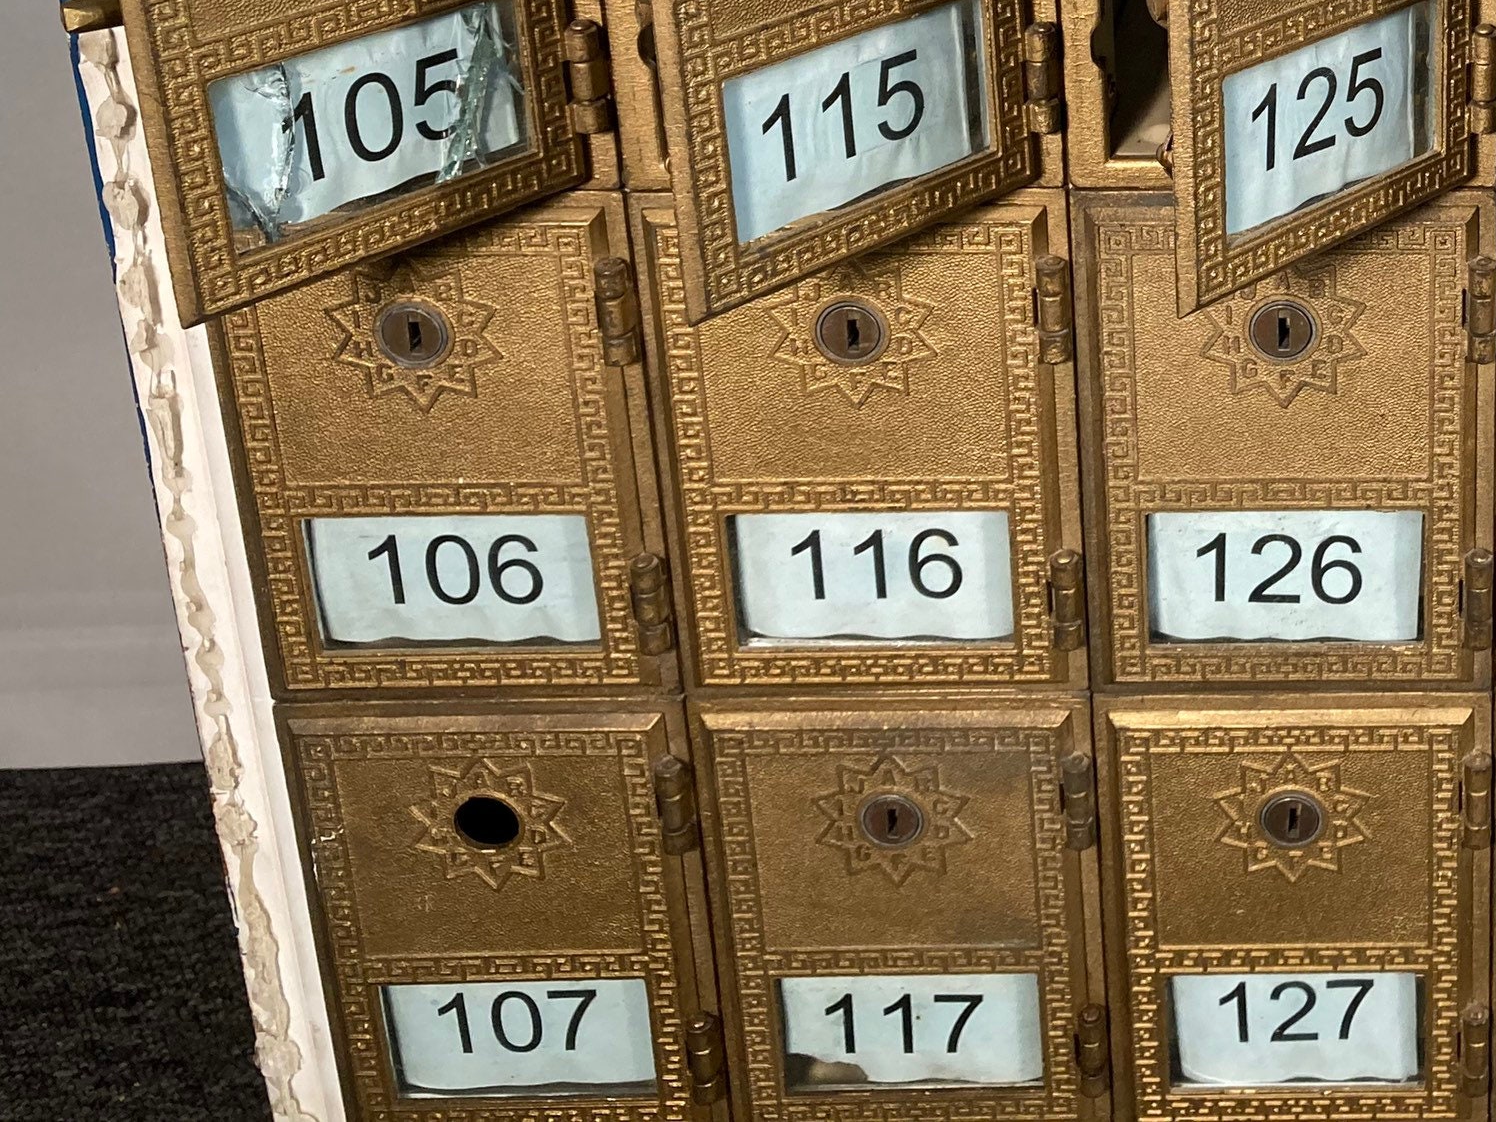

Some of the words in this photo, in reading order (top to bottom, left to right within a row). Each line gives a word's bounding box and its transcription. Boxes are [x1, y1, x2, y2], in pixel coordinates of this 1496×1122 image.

[282, 47, 466, 182] 105
[763, 49, 924, 181] 115
[1252, 47, 1385, 171] 125
[369, 535, 543, 604] 106
[792, 529, 962, 599] 116
[1197, 533, 1362, 604] 126
[438, 990, 596, 1053] 107
[825, 994, 983, 1053] 117
[1220, 980, 1373, 1042] 127
